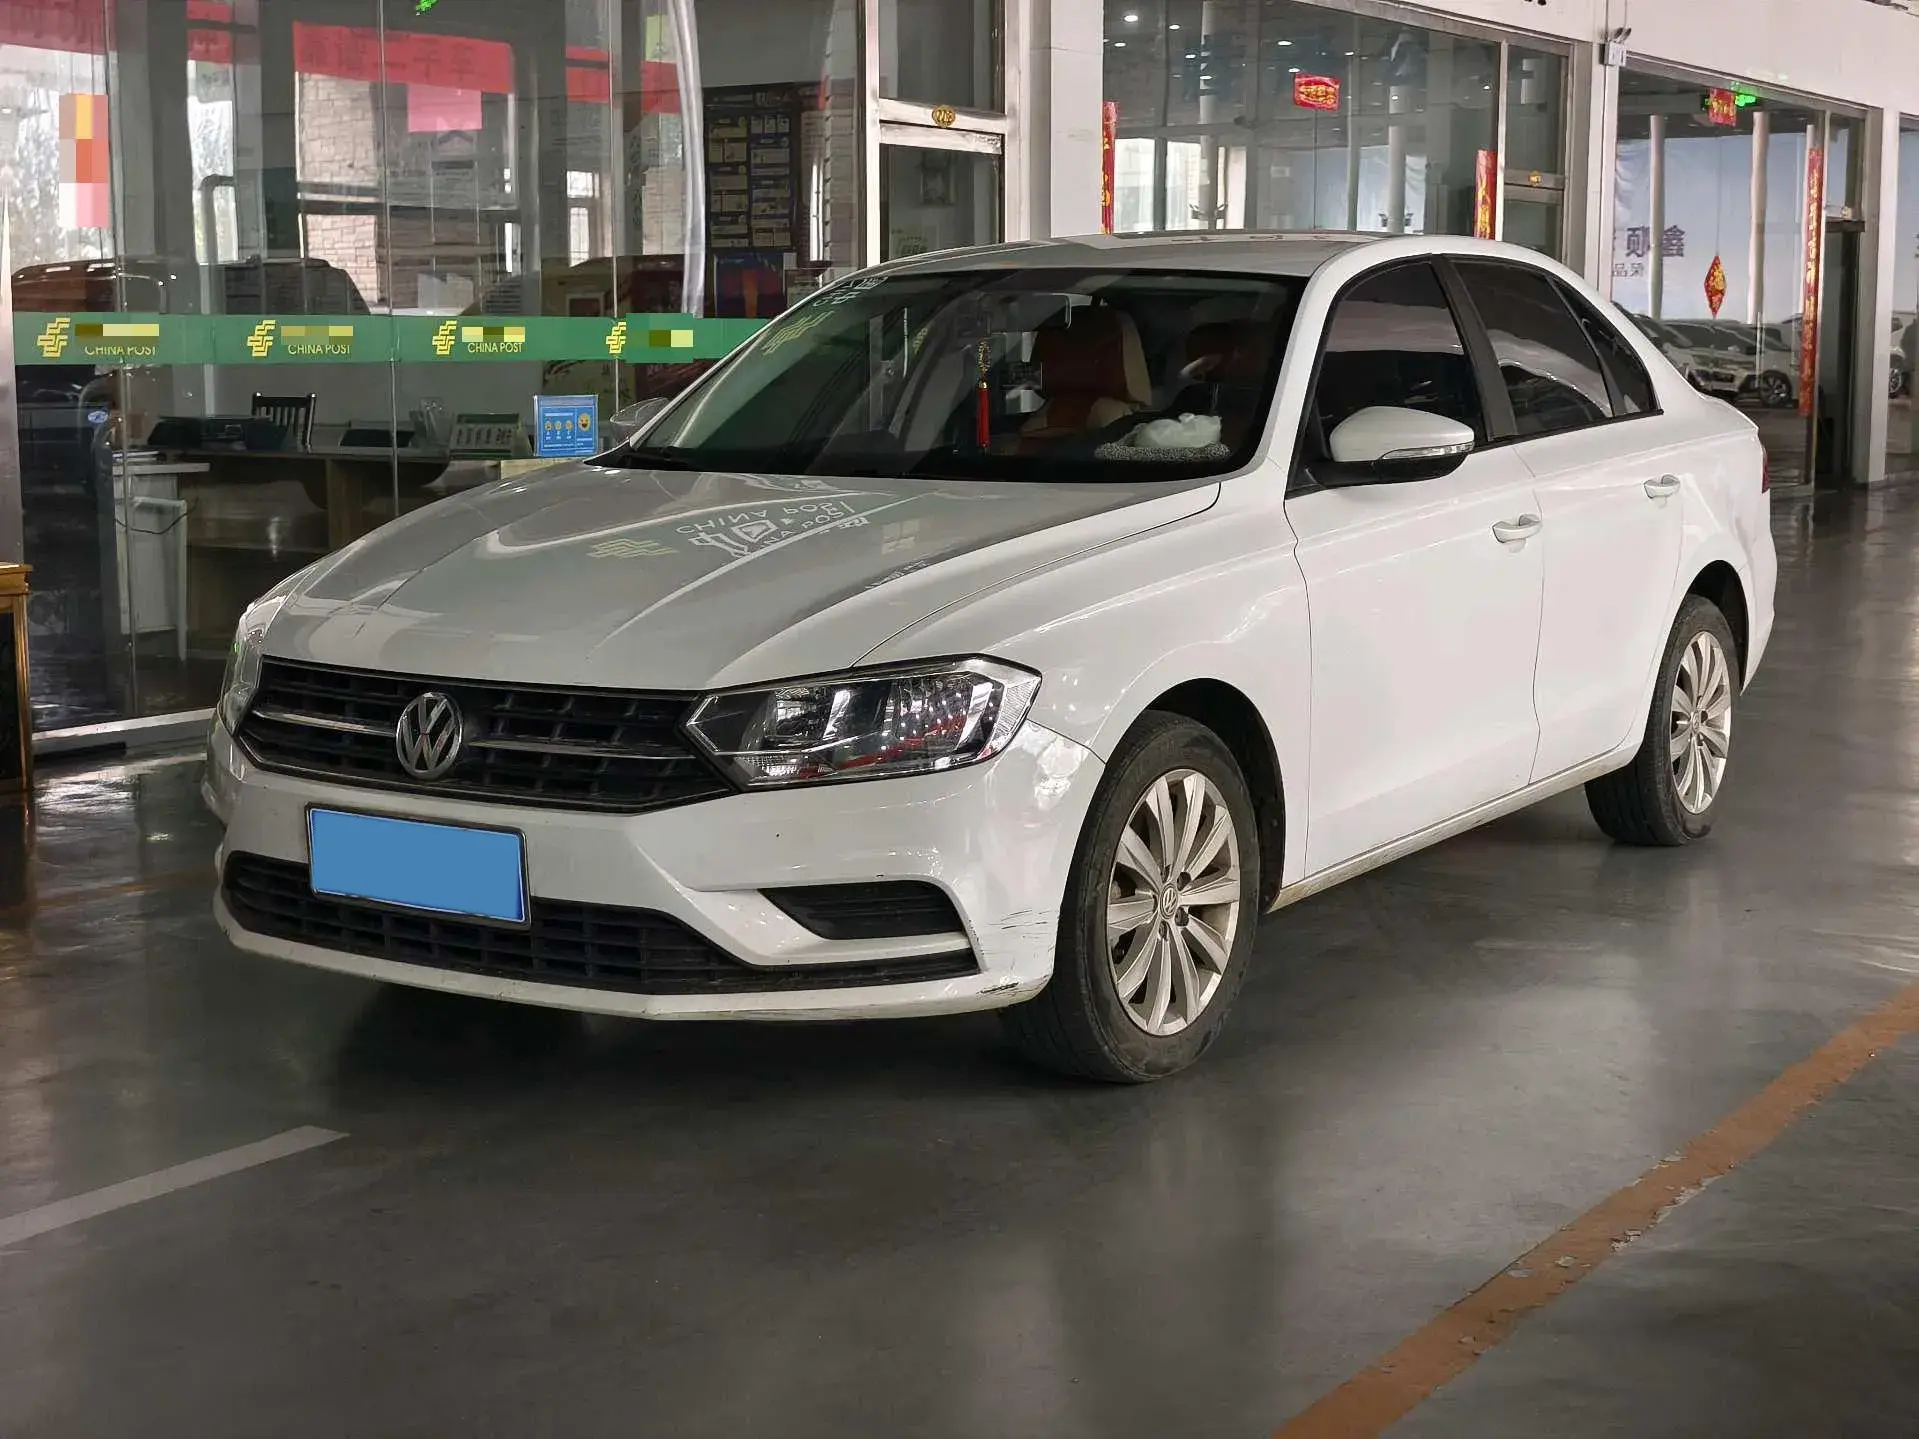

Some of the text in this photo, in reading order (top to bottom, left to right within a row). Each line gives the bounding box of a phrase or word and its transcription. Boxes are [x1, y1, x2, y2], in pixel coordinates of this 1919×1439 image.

[288, 343, 351, 355] CHINA POST
[467, 342, 523, 354] CHINA POST
